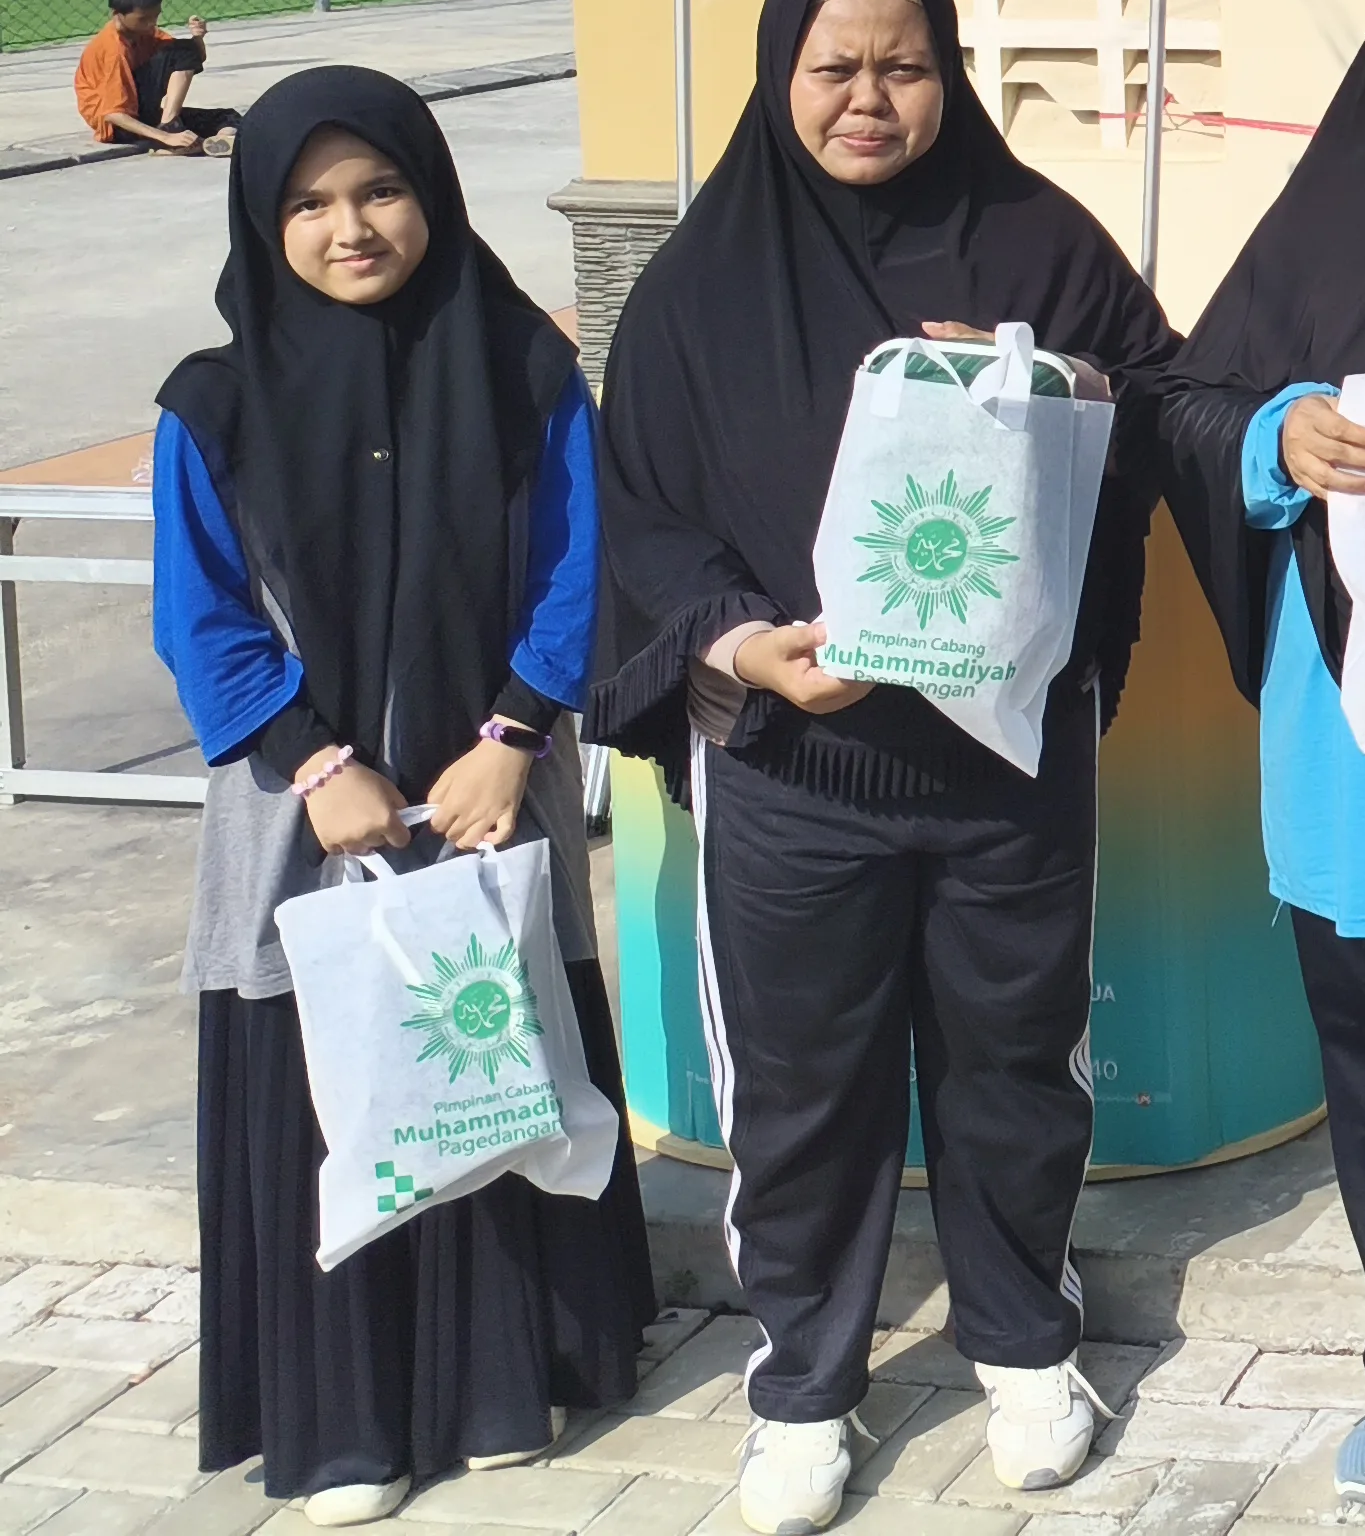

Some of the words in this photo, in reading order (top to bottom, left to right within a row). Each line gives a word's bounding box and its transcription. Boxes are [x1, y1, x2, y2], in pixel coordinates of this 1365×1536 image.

[858, 629, 927, 650] Pimpinan
[930, 637, 986, 659] Cabang
[433, 1091, 502, 1115] Pimpinan
[504, 1079, 557, 1100] Cabang
